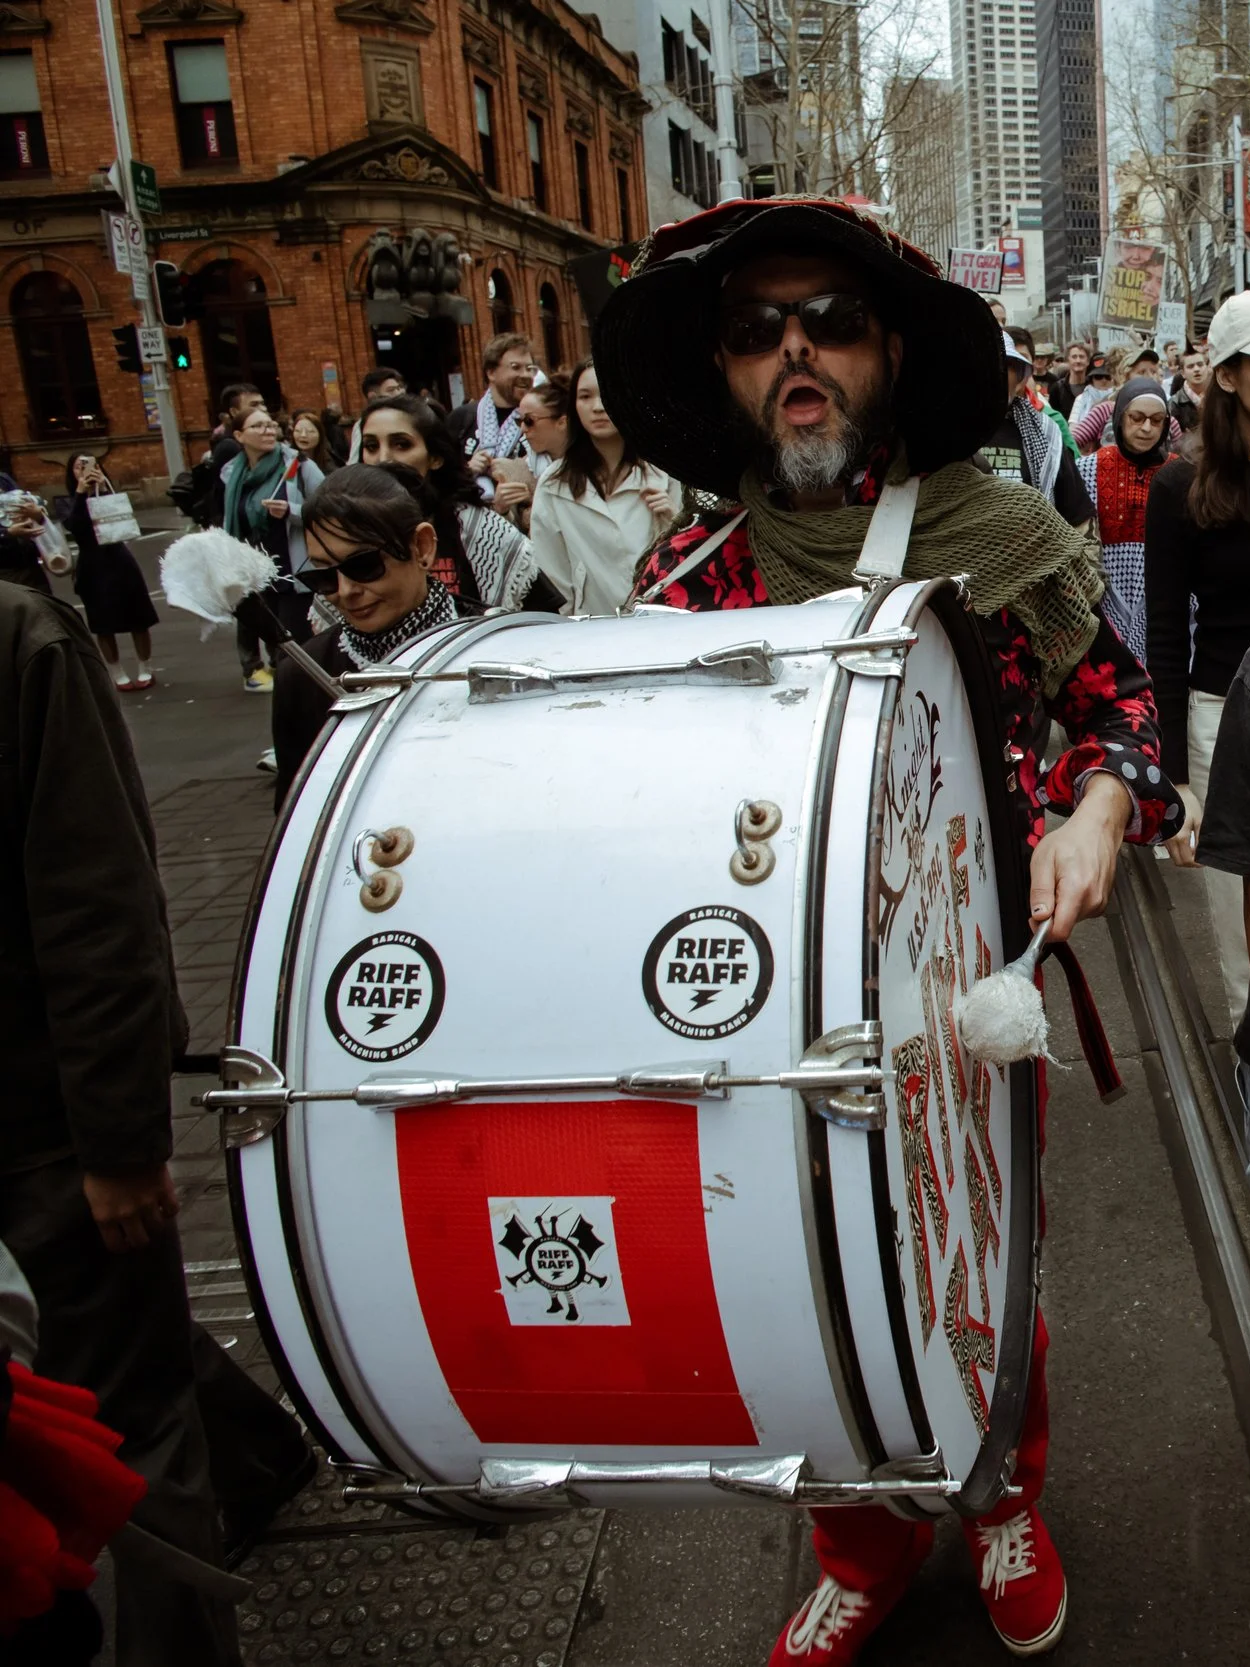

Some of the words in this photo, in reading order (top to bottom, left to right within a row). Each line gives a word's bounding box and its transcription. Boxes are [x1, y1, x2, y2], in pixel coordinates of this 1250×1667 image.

[159, 229, 199, 241] Liverpool
[200, 227, 209, 237] St
[952, 253, 975, 267] LET
[976, 254, 1001, 268] GAZA
[951, 269, 996, 289] LIVE!
[1108, 267, 1146, 289] STOP
[1103, 296, 1153, 320] ISRAEL
[141, 330, 159, 339] ONE
[142, 340, 161, 350] WAY
[689, 908, 739, 922] RADICAL
[371, 933, 418, 947] RADICAL
[675, 938, 746, 959] RIFF
[356, 962, 421, 985] RIFF
[666, 962, 749, 985] RAFF
[347, 986, 422, 1009] RAFF
[659, 1011, 716, 1037] MARCHING
[718, 1012, 748, 1034] BAND
[338, 1033, 388, 1060] MARCHING
[391, 1037, 420, 1057] BAND
[537, 1260, 574, 1269] RAFF
[538, 1250, 569, 1259] RIFF
